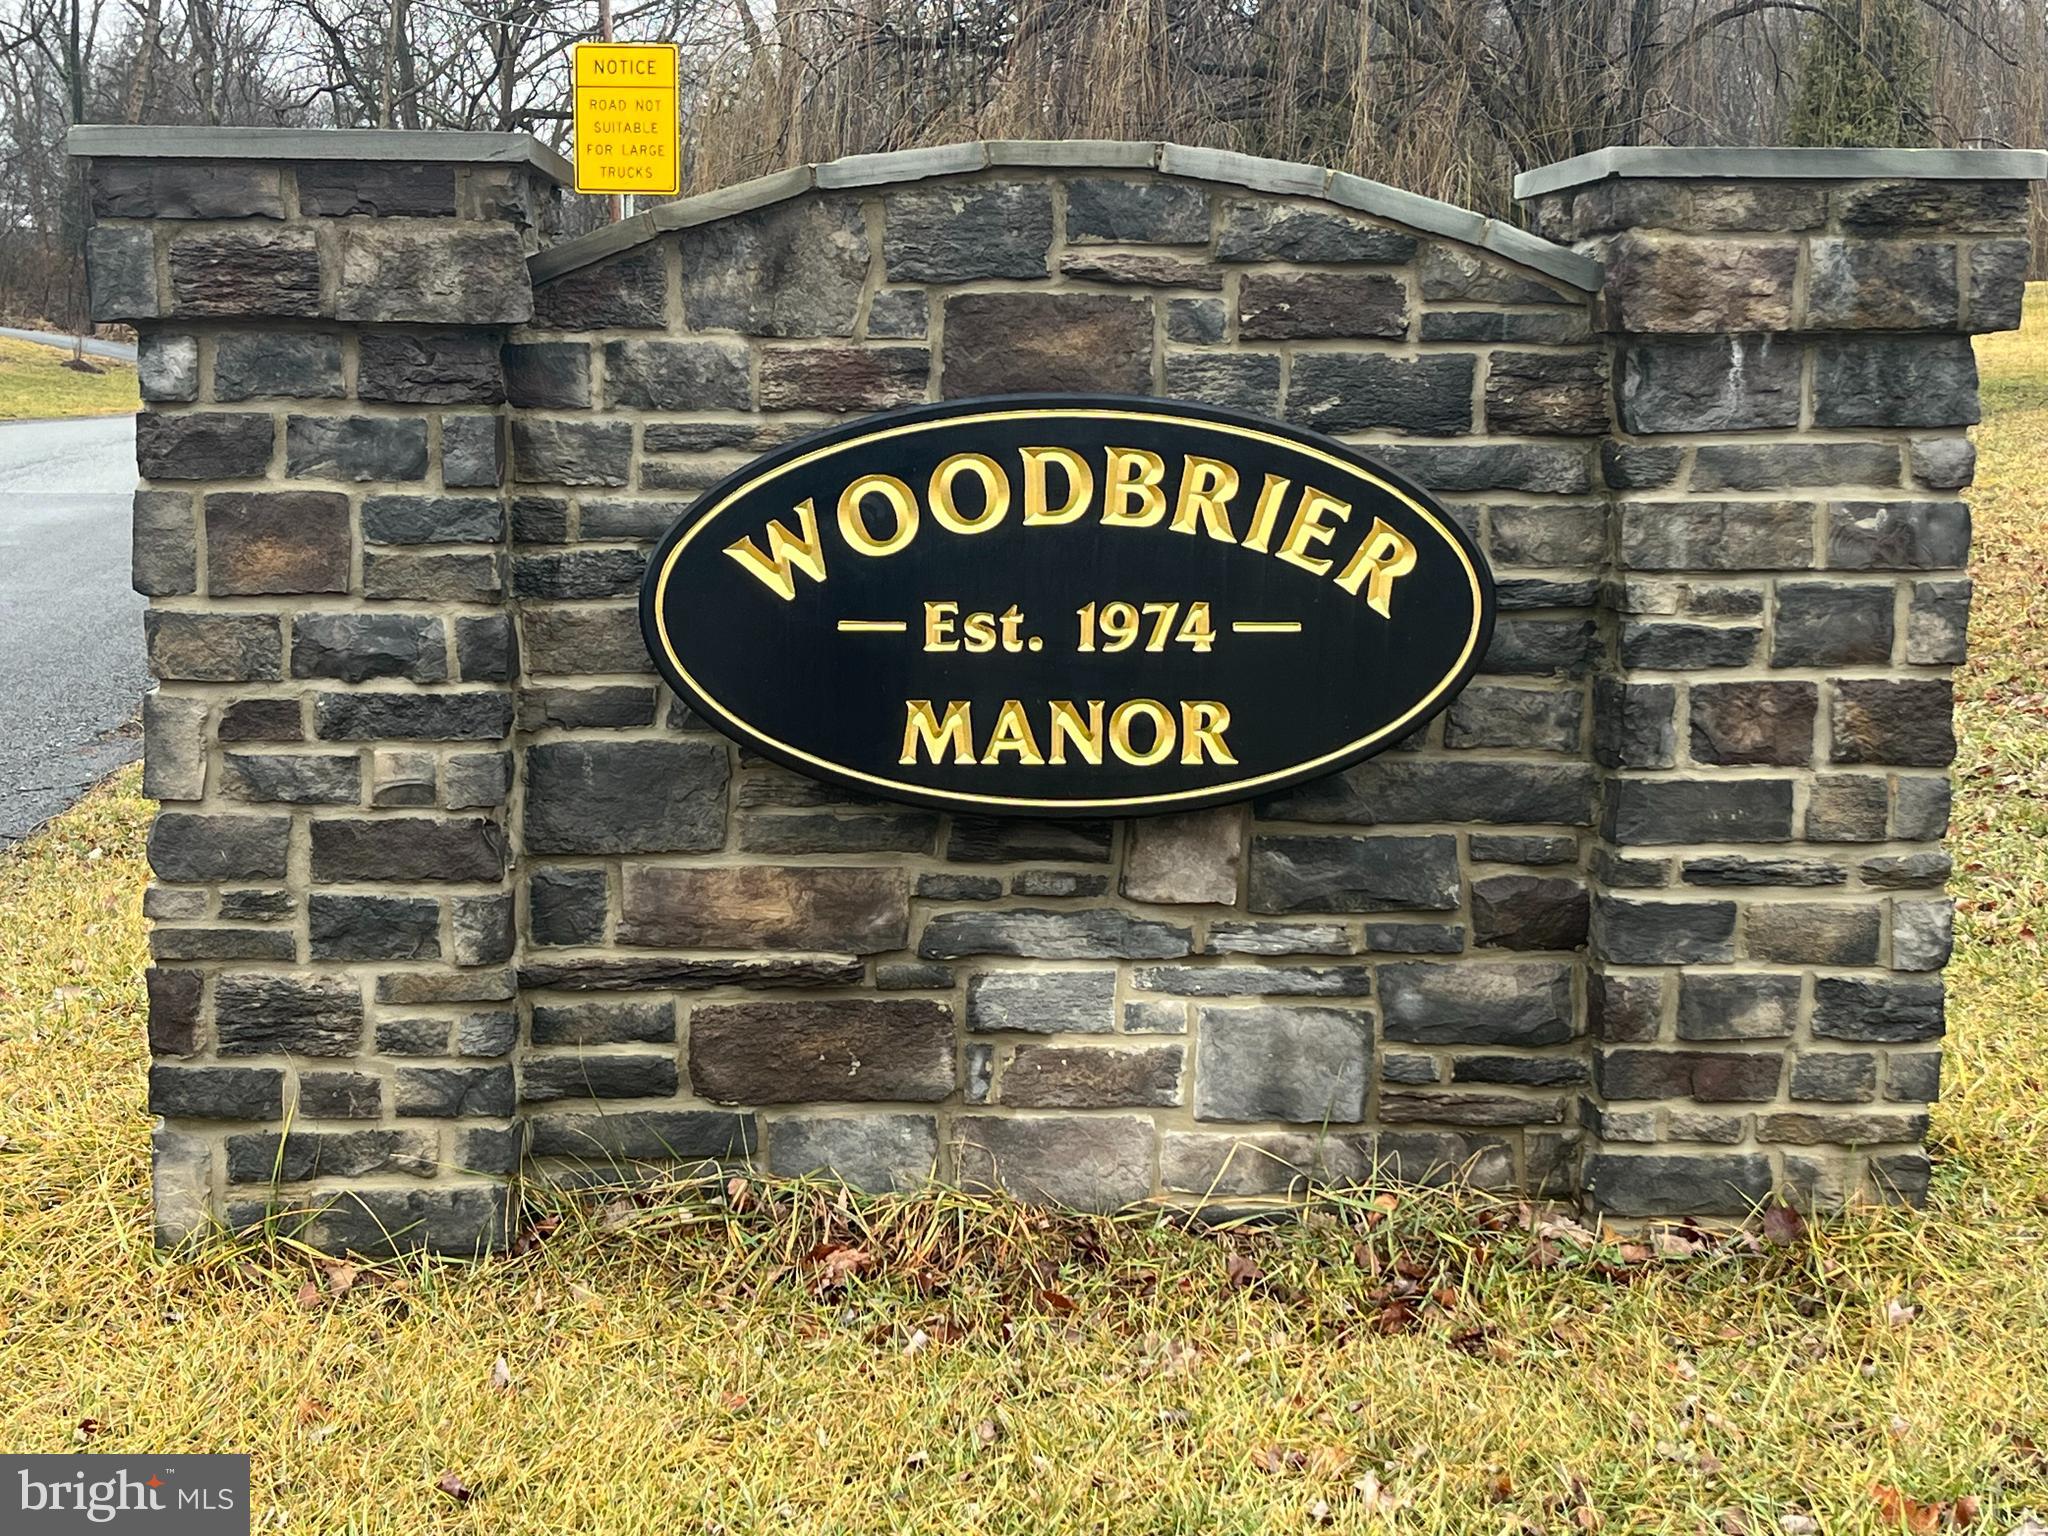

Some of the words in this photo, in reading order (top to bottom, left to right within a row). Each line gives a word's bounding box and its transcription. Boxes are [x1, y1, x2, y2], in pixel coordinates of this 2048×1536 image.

[594, 60, 656, 75] NOTICE
[589, 99, 627, 112] ROAD
[635, 99, 661, 112] NOT
[594, 121, 659, 134] SUITABLE
[587, 144, 613, 156] FOR
[622, 144, 665, 156] LARGE
[600, 166, 653, 179] TRUCKS
[722, 445, 1419, 620] WOODBRIER
[922, 601, 1044, 653] Est.
[1075, 600, 1216, 653] 1974
[898, 699, 1239, 766] MANOR
